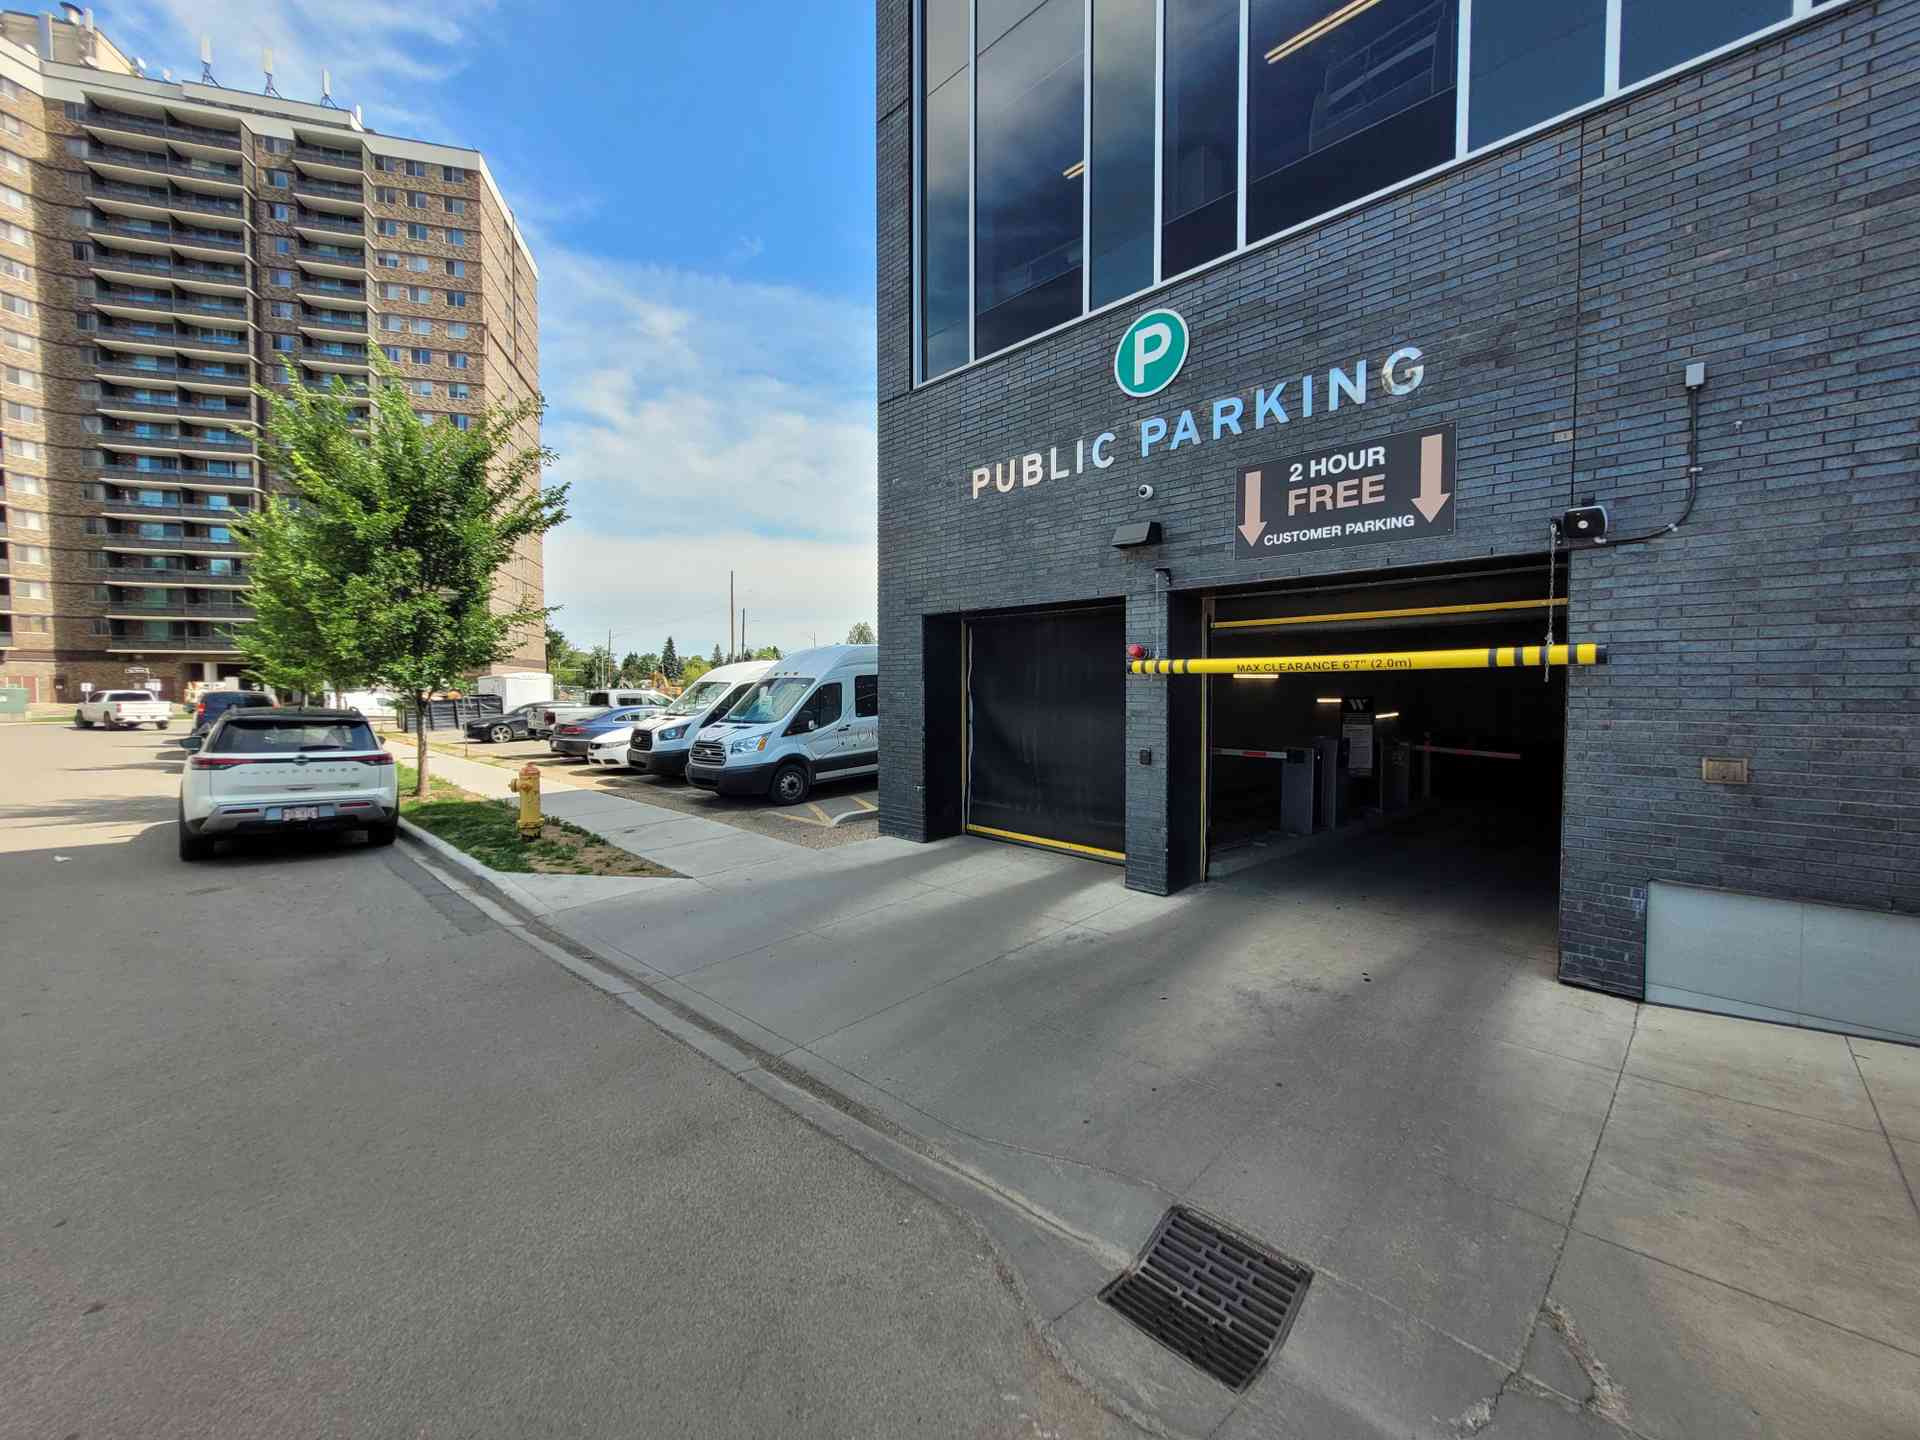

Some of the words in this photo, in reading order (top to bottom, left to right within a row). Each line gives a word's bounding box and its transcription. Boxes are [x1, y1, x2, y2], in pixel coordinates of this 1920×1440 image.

[1134, 322, 1172, 386] P
[972, 432, 1117, 500] PUBLIC
[1140, 346, 1425, 459] PARKING
[1289, 463, 1303, 482] 2
[1309, 446, 1386, 478] HOUR
[1287, 474, 1386, 516] FREE
[1263, 524, 1342, 546] CUSTOMER
[1345, 514, 1415, 535] PARKING
[1236, 663, 1260, 673] MAX
[1264, 661, 1338, 672] CLEARANCE
[1343, 659, 1367, 670] 6'7"
[1370, 657, 1413, 669] (2.0m)
